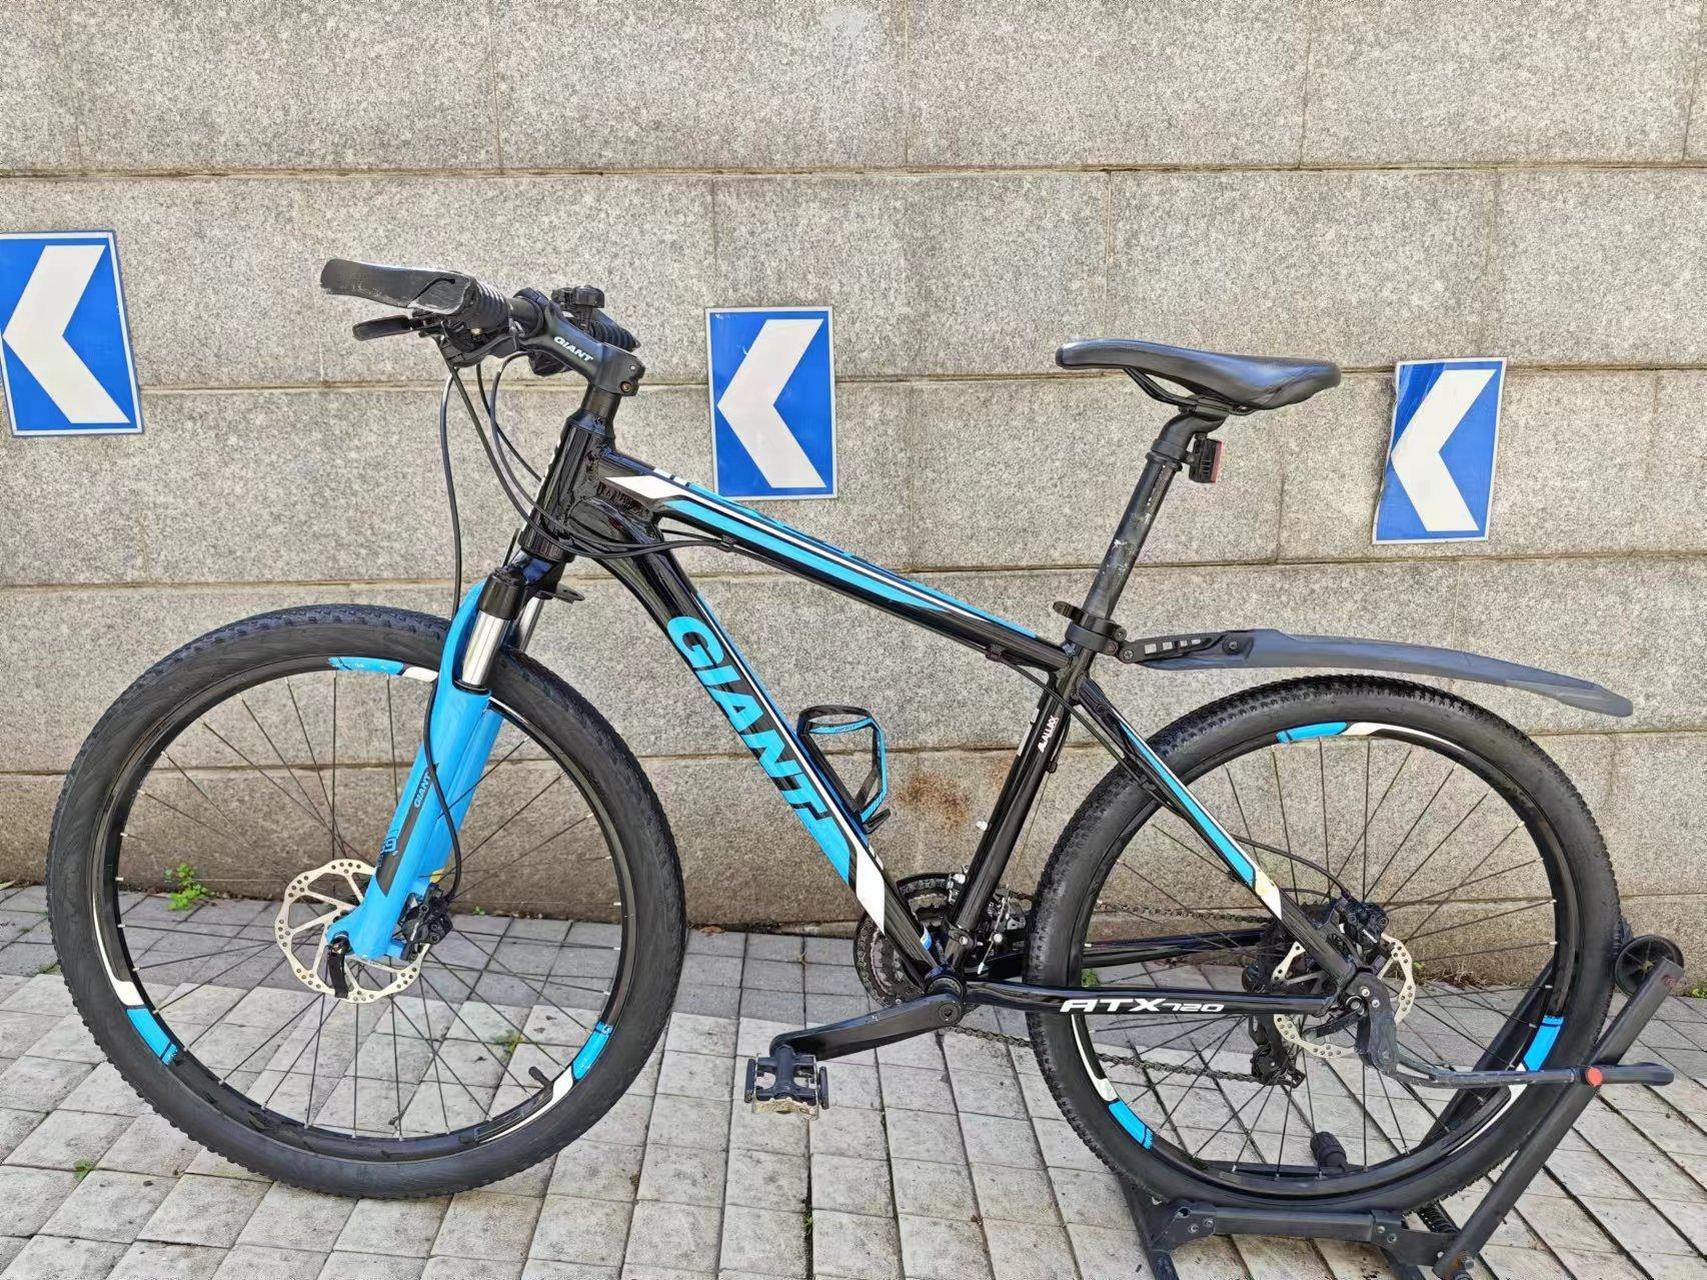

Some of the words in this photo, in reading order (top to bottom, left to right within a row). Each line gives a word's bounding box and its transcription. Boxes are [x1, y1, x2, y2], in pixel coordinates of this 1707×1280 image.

[553, 336, 594, 362] GIANT
[667, 616, 828, 815] GIANT
[414, 770, 431, 808] GIANT
